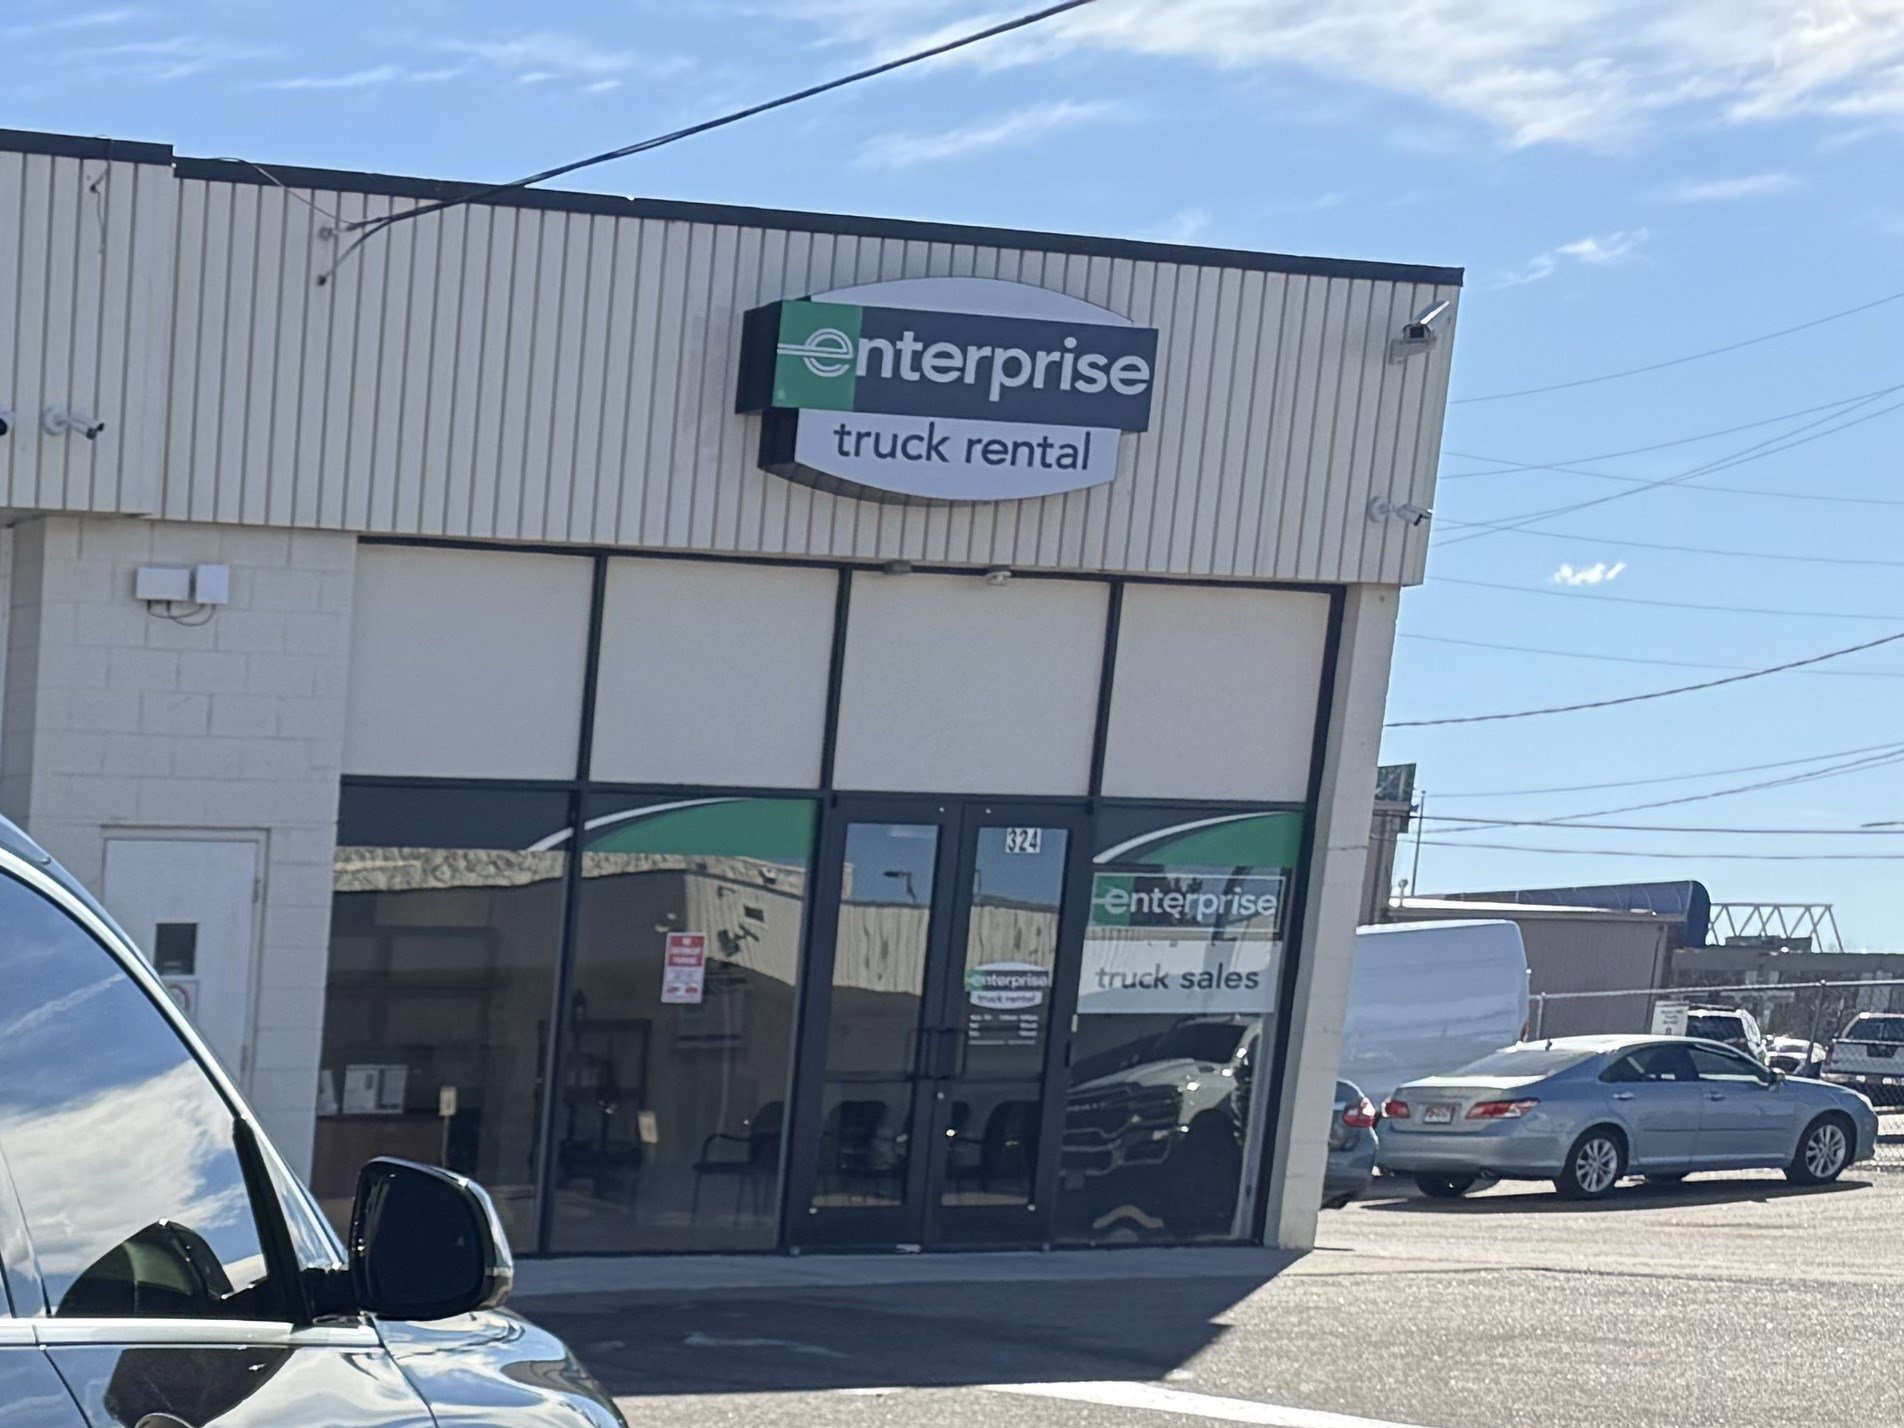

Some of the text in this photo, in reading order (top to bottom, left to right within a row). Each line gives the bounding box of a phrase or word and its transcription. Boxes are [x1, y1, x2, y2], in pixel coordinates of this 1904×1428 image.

[778, 327, 1151, 402] enterprise
[832, 421, 1092, 472] truck rental
[1006, 829, 1039, 853] 324
[1093, 887, 1278, 922] enterprise
[968, 972, 1048, 988] enterprise
[1095, 962, 1261, 990] truck sales
